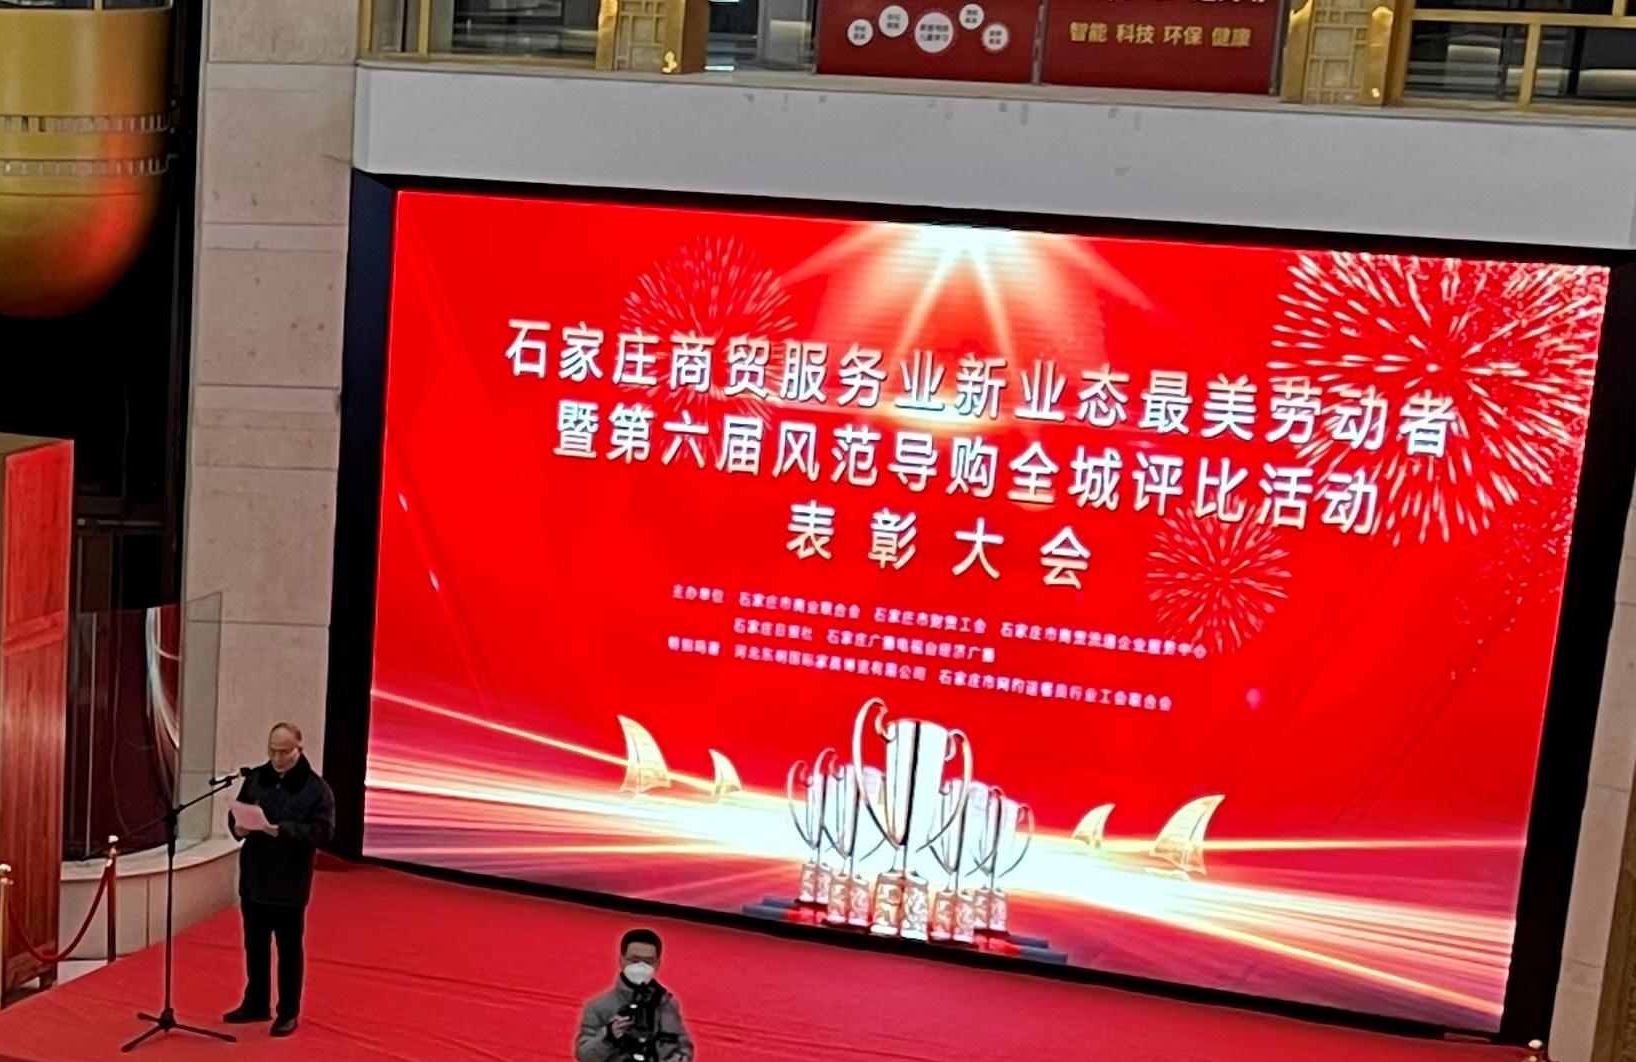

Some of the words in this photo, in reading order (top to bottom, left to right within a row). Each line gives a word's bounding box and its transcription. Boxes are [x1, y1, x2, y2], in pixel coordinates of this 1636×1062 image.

[1070, 21, 1108, 43] 智能
[1116, 23, 1155, 44] 科技
[1163, 25, 1202, 46] 环保
[1212, 27, 1251, 47] 健康
[504, 318, 1458, 460] 石家庄商贸服务业新业态最美劳动者
[552, 400, 1380, 538] 暨第六届风范导购全城评比活动
[785, 507, 1093, 592] 表彰大会
